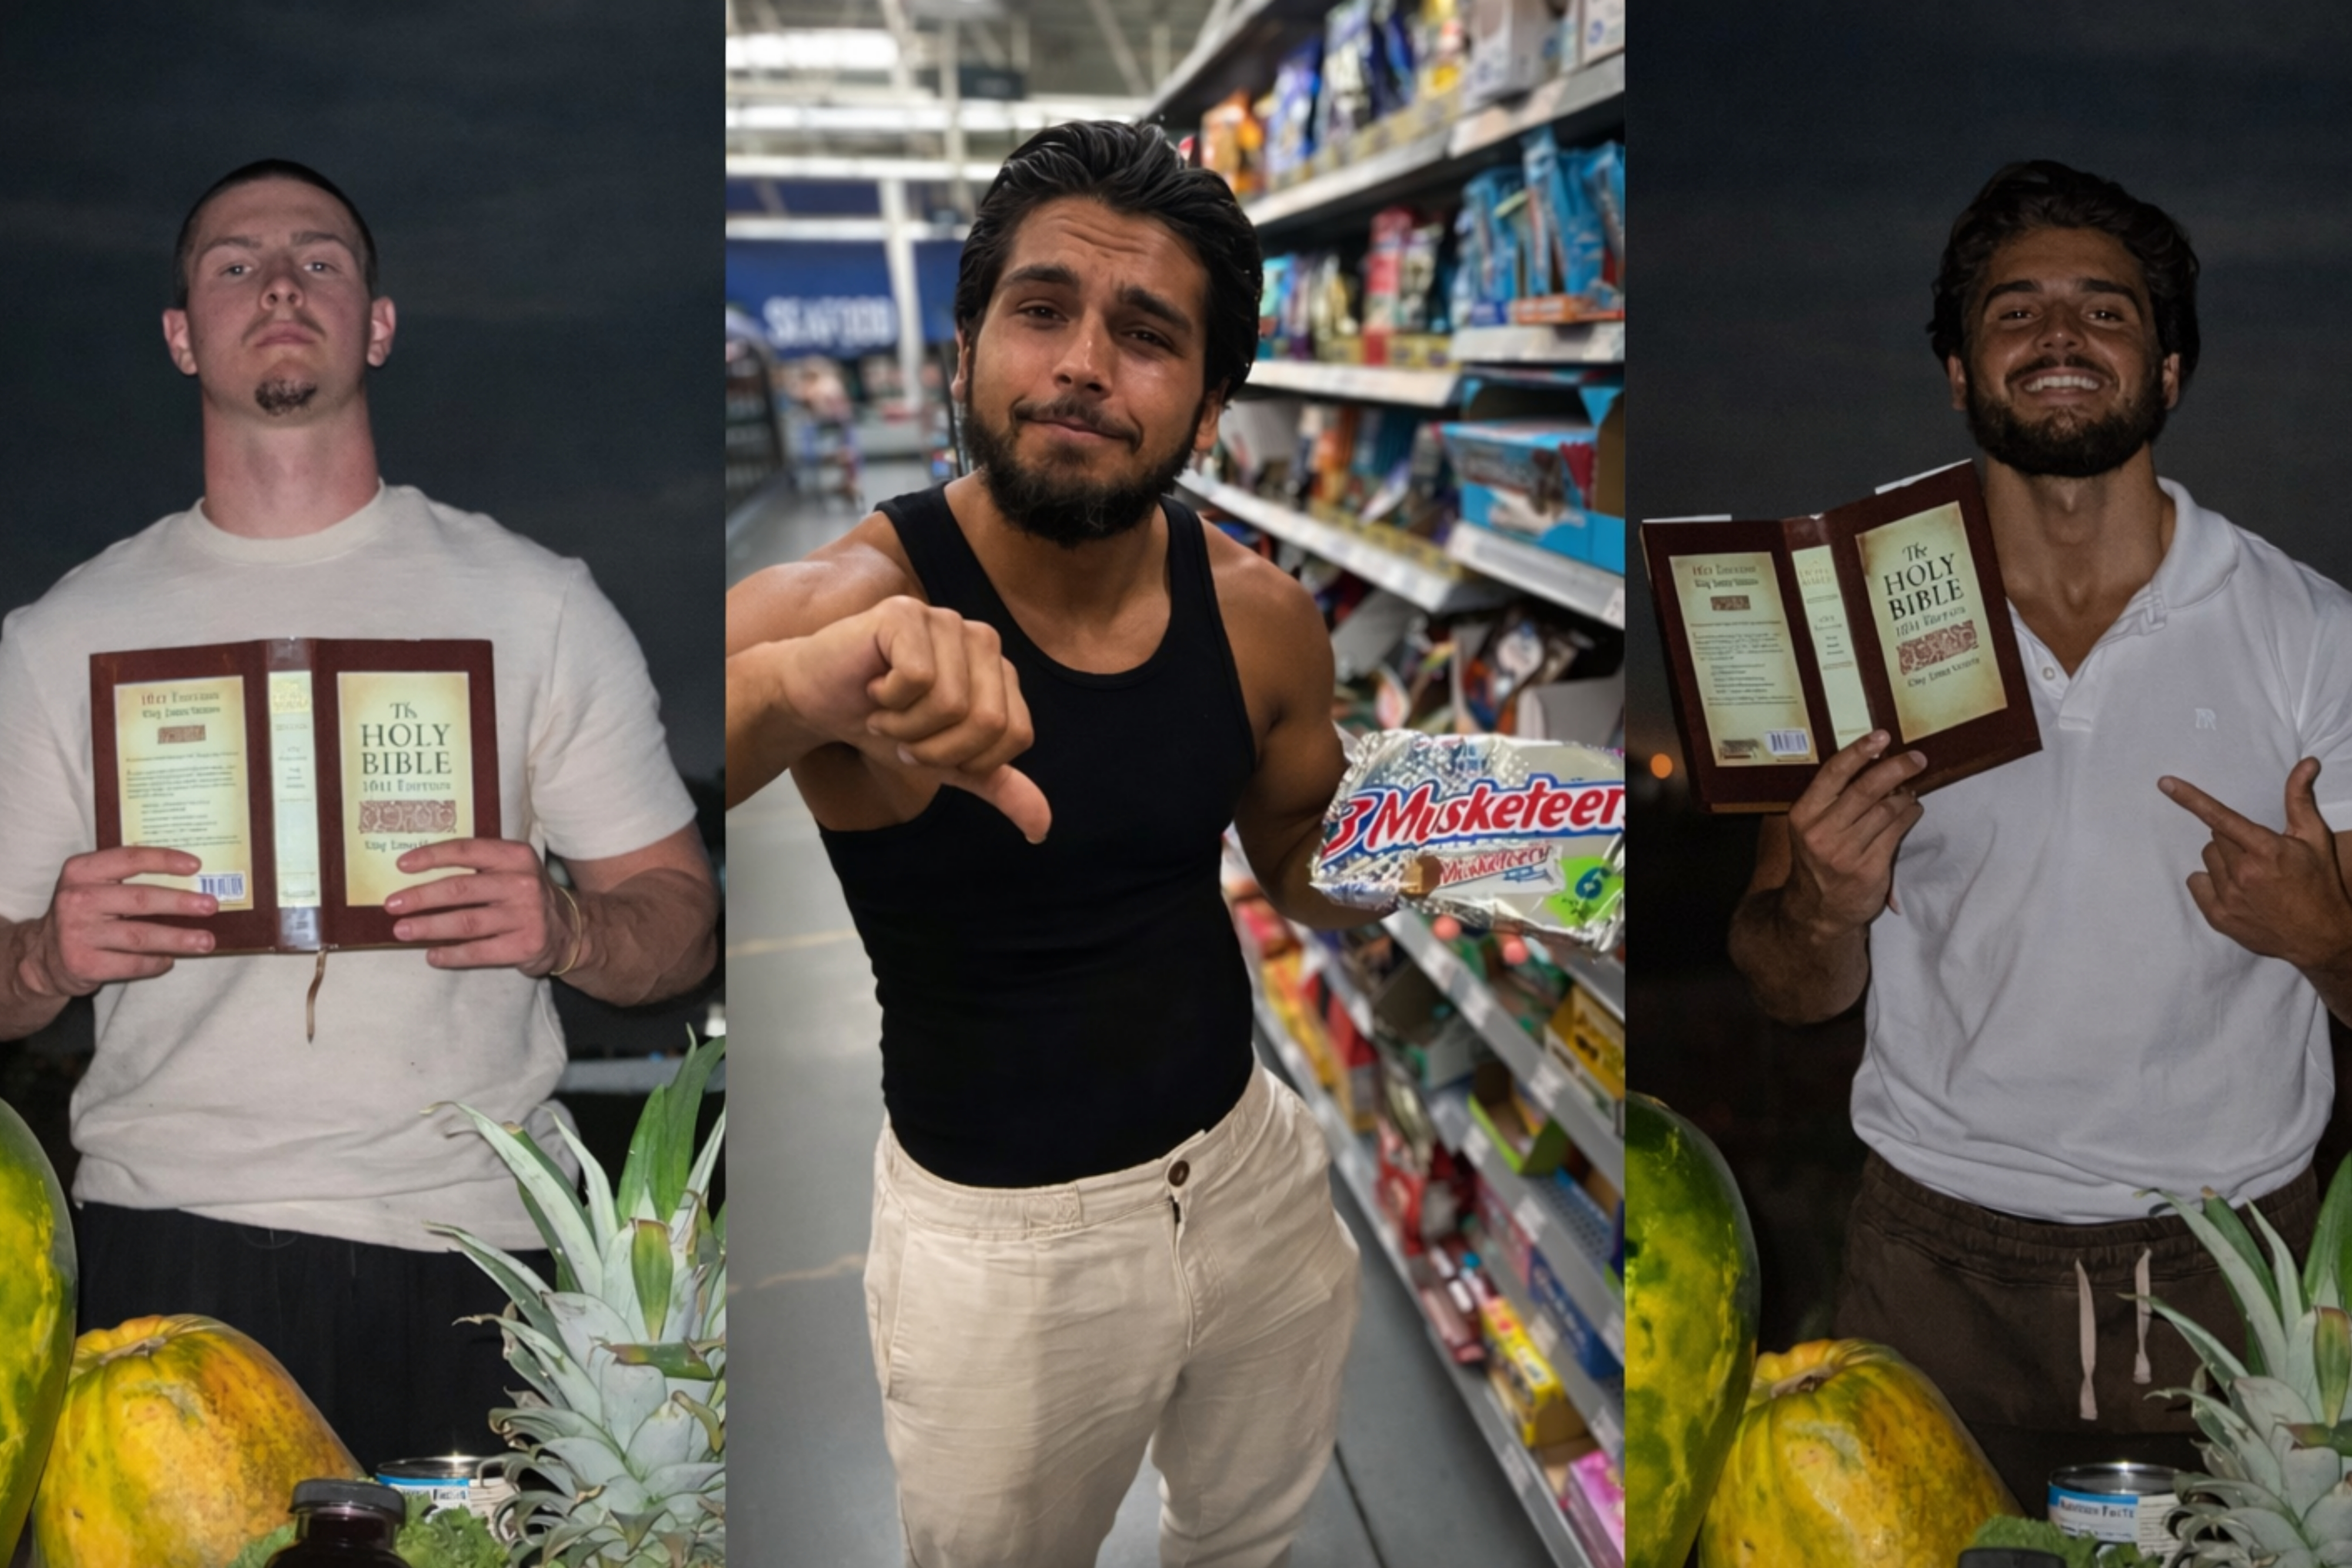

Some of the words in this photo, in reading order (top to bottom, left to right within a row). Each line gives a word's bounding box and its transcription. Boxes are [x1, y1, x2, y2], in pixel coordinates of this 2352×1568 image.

[1884, 553, 1955, 596] HOLY
[1888, 578, 1965, 621] BIBLE
[360, 723, 452, 748] HOLY
[361, 751, 452, 775] BIBLE
[1323, 799, 1375, 859] 3
[1367, 781, 1625, 849] Musketeer
